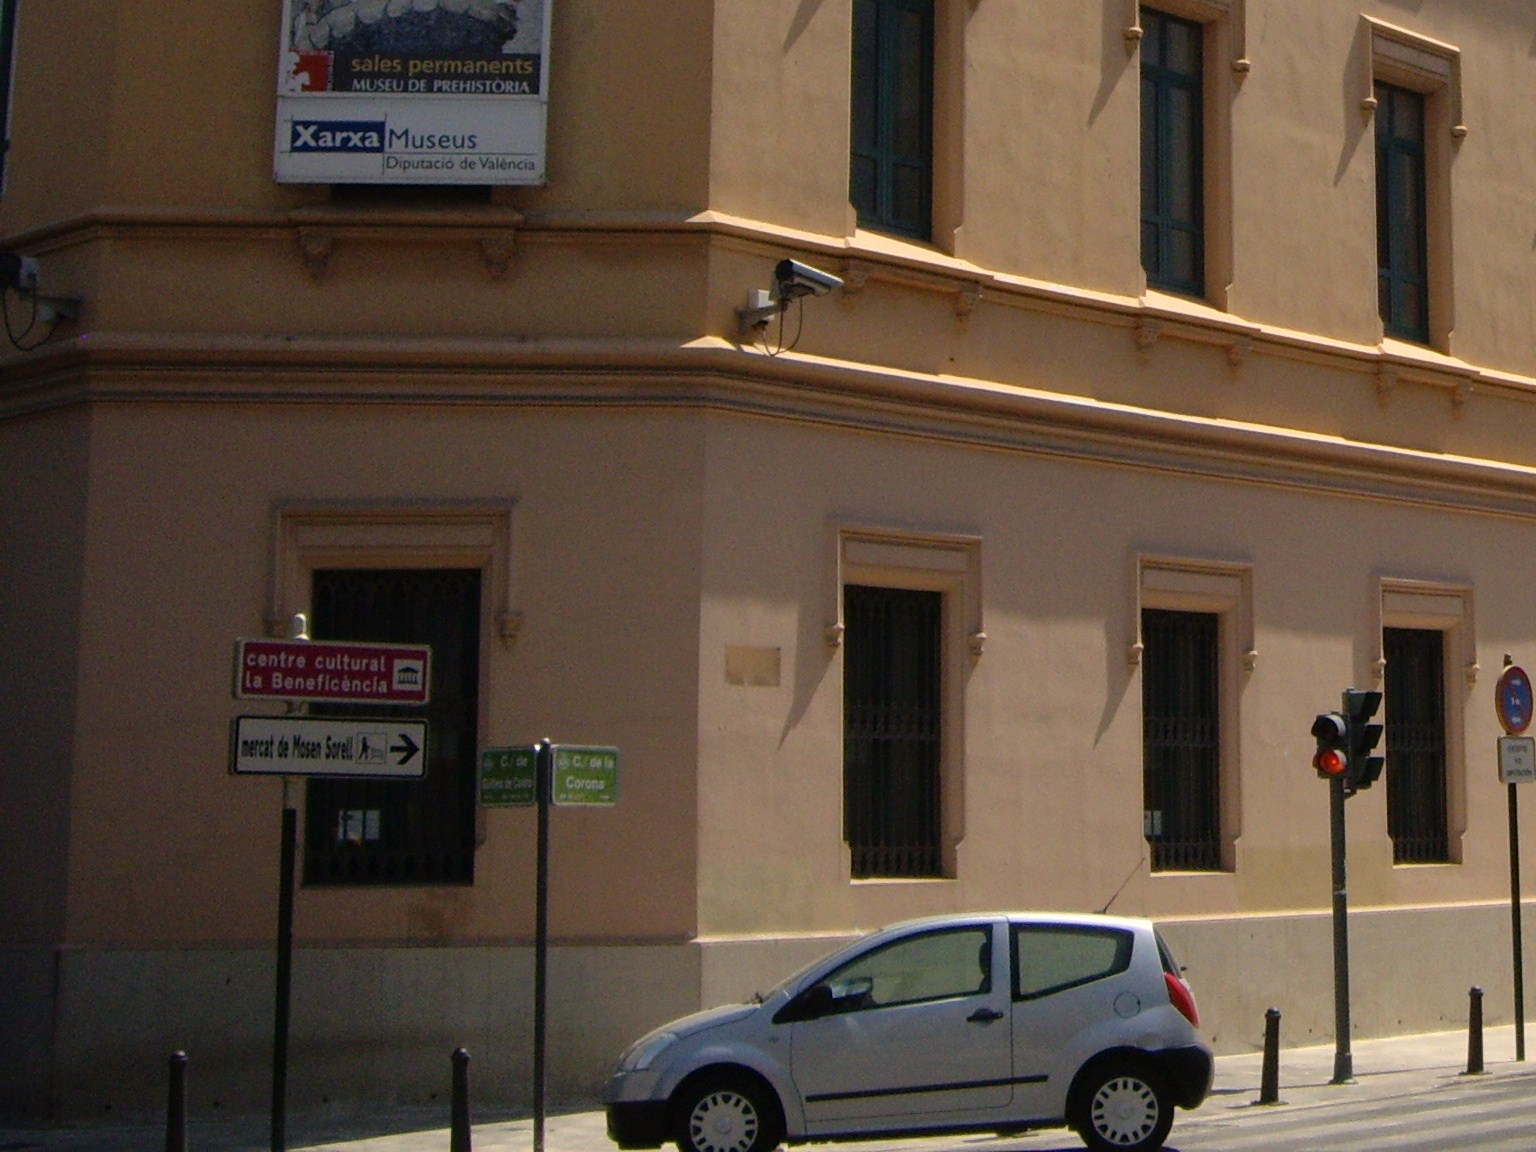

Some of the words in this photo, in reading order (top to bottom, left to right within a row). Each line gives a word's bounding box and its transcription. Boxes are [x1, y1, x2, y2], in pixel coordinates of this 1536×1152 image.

[351, 54, 401, 72] sales
[408, 57, 533, 76] permanents
[351, 79, 404, 92] MUSEU
[408, 79, 428, 92] DE
[433, 76, 530, 94] PREHISTÒRIA
[293, 124, 380, 148] Xarxa
[388, 128, 478, 149] Museus
[385, 156, 454, 171] Diputació
[459, 157, 477, 170] de
[478, 157, 536, 171] València
[246, 652, 306, 668] centre
[315, 654, 386, 672] cultural
[245, 671, 262, 689] la
[272, 672, 388, 694] Beneficència
[241, 734, 274, 759] mercat
[278, 735, 289, 759] de
[325, 735, 354, 761] Sorell
